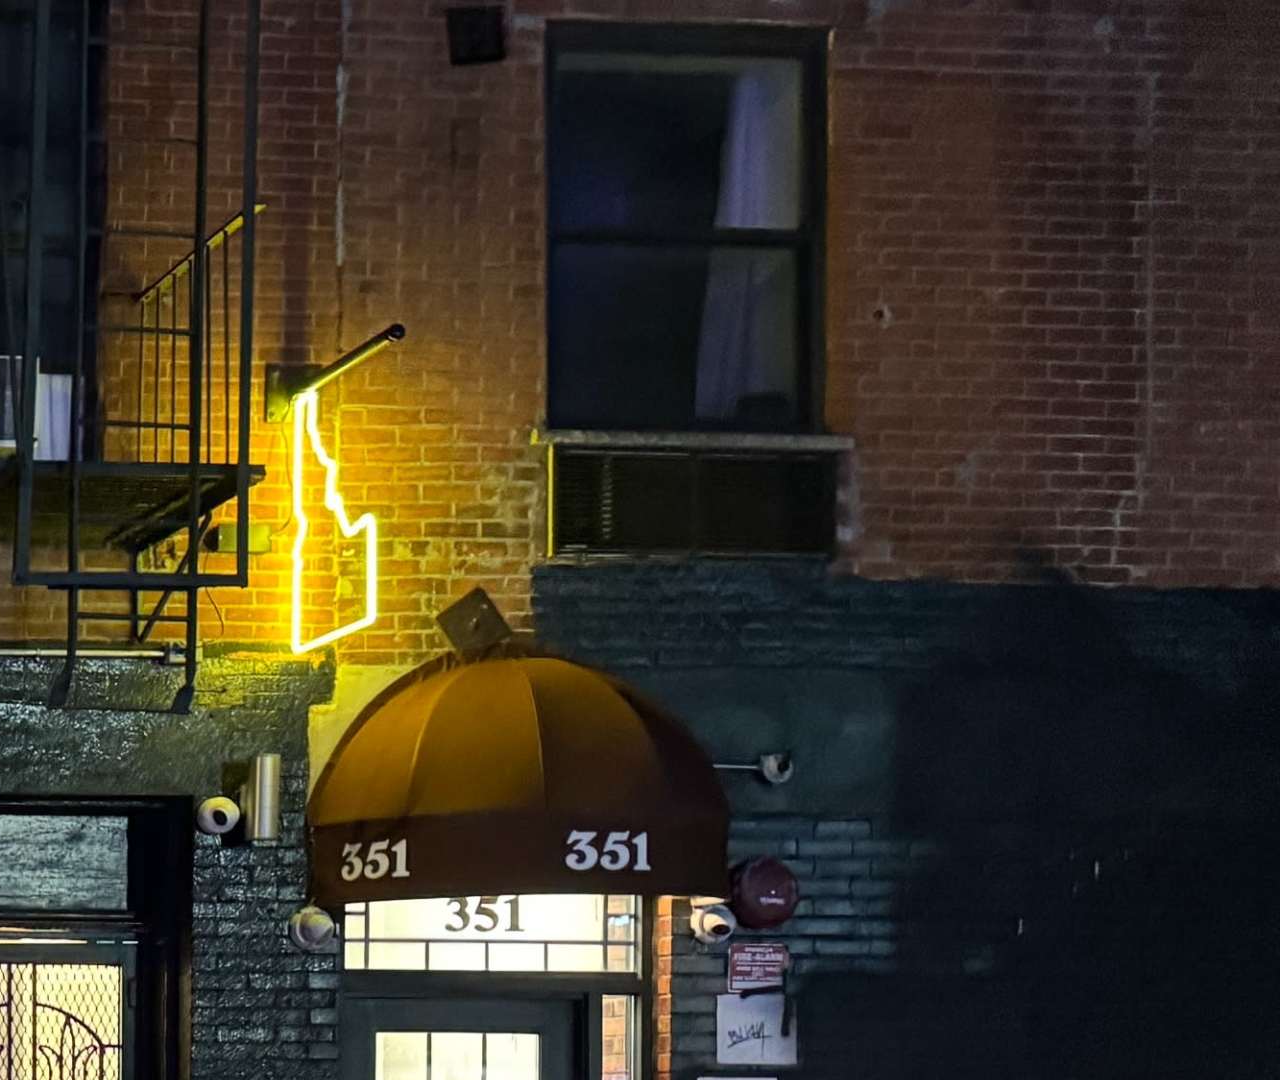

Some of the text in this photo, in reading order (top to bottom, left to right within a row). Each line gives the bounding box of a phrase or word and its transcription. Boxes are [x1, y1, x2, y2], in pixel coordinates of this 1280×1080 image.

[341, 838, 410, 881] 351
[565, 830, 651, 871] 351
[445, 896, 525, 932] 351
